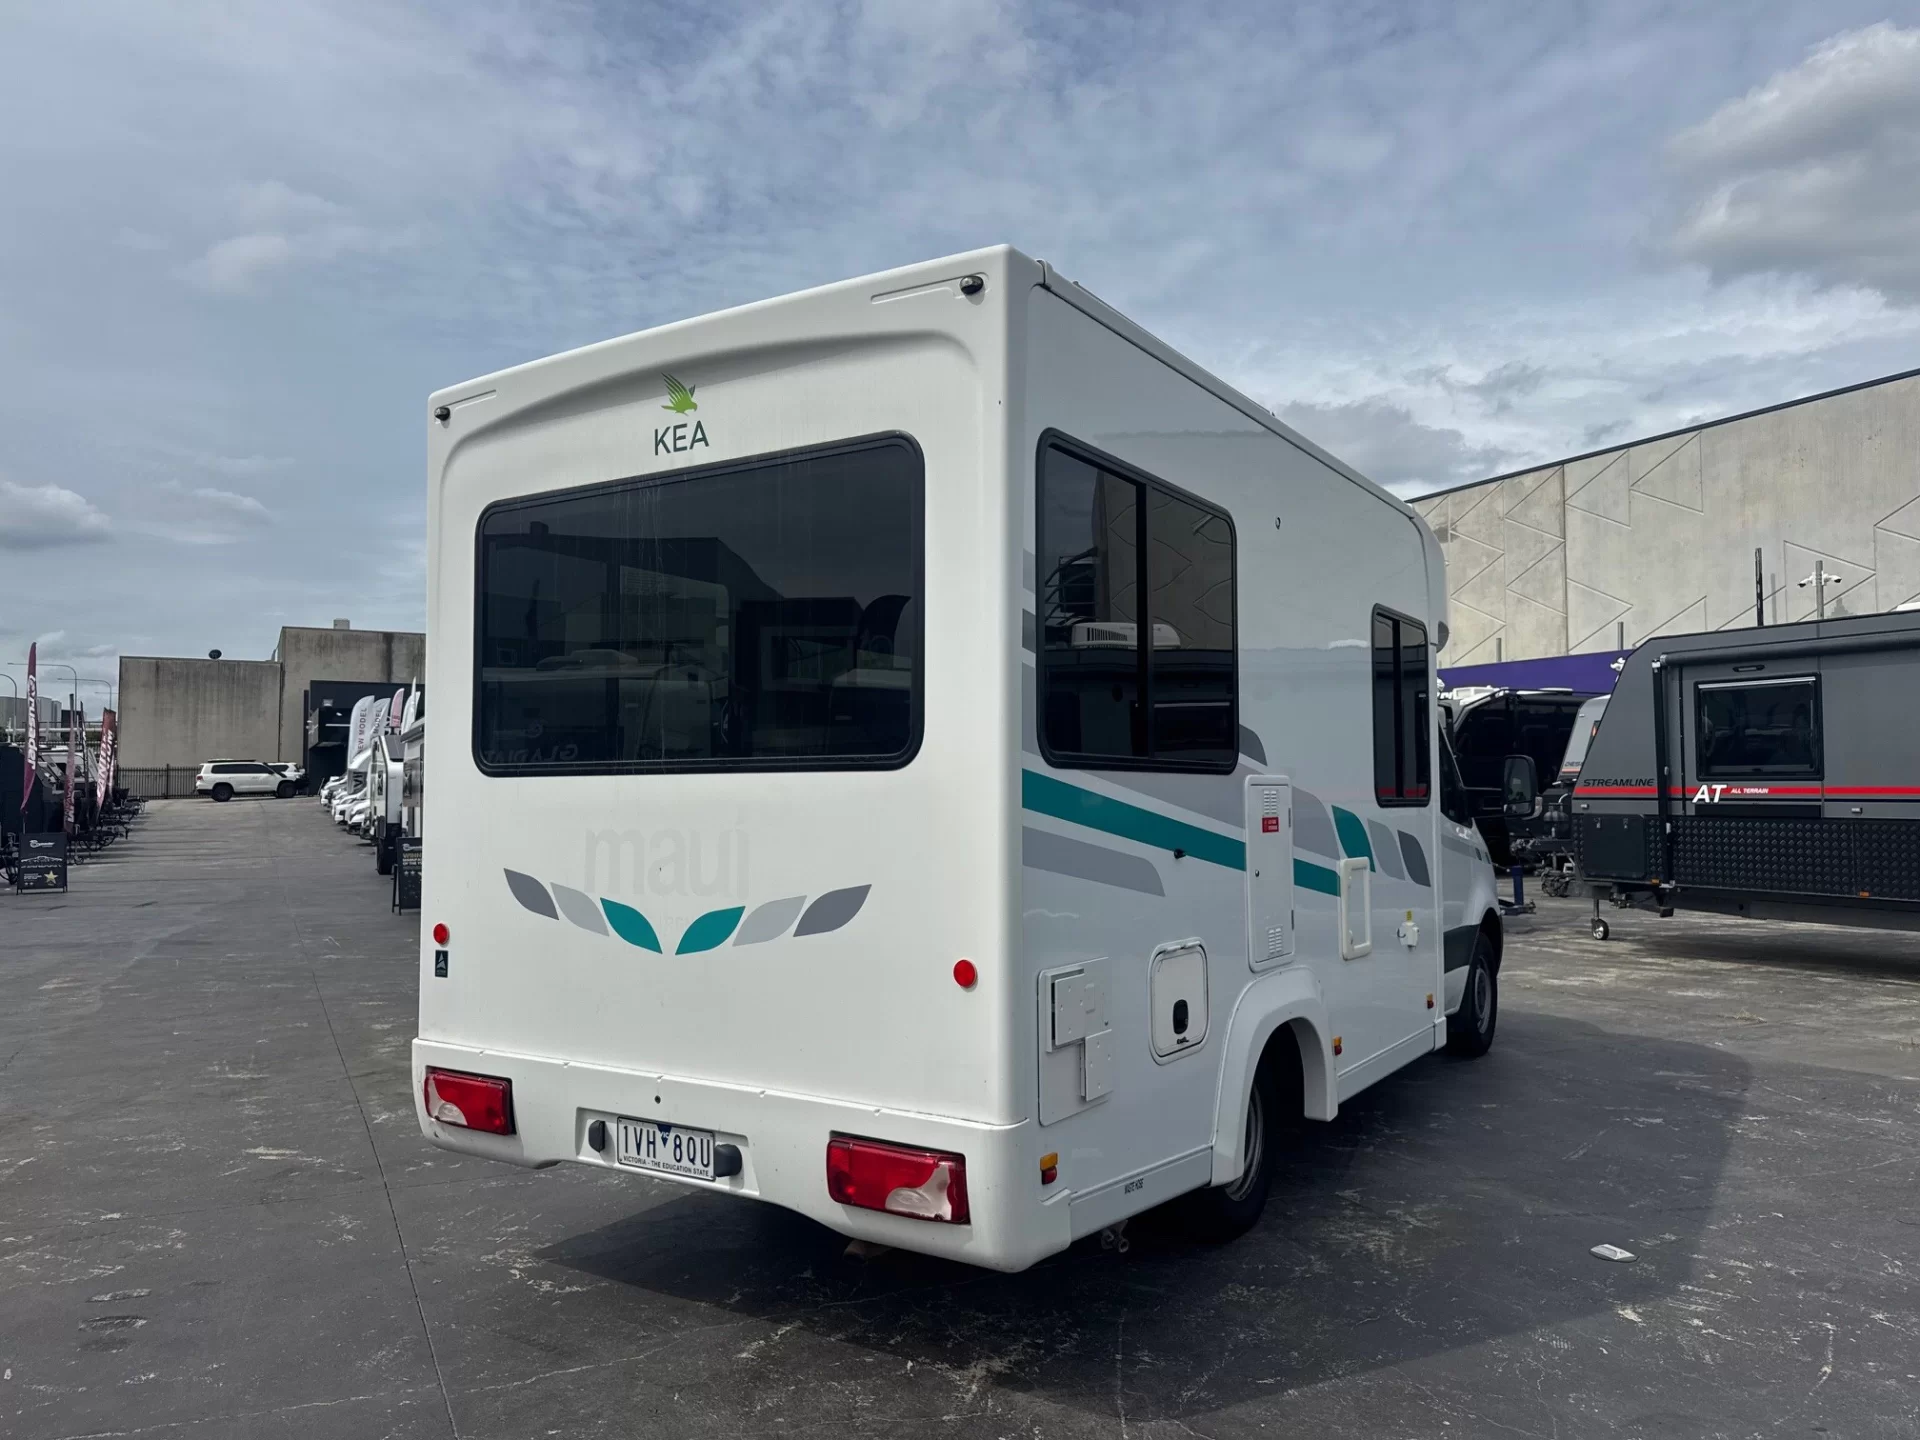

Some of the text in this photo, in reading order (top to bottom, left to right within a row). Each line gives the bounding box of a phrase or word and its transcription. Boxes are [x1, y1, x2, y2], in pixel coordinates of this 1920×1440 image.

[654, 419, 710, 456] KEA
[359, 707, 367, 736] MODEL
[1584, 778, 1655, 787] STREAMLINE
[1691, 784, 1728, 803] AT
[623, 1125, 710, 1168] 1VH 8QU
[623, 1155, 647, 1166] VICTORIA
[651, 1160, 661, 1168] THE
[662, 1162, 692, 1174] EDUCATION
[693, 1167, 709, 1177] STATE
